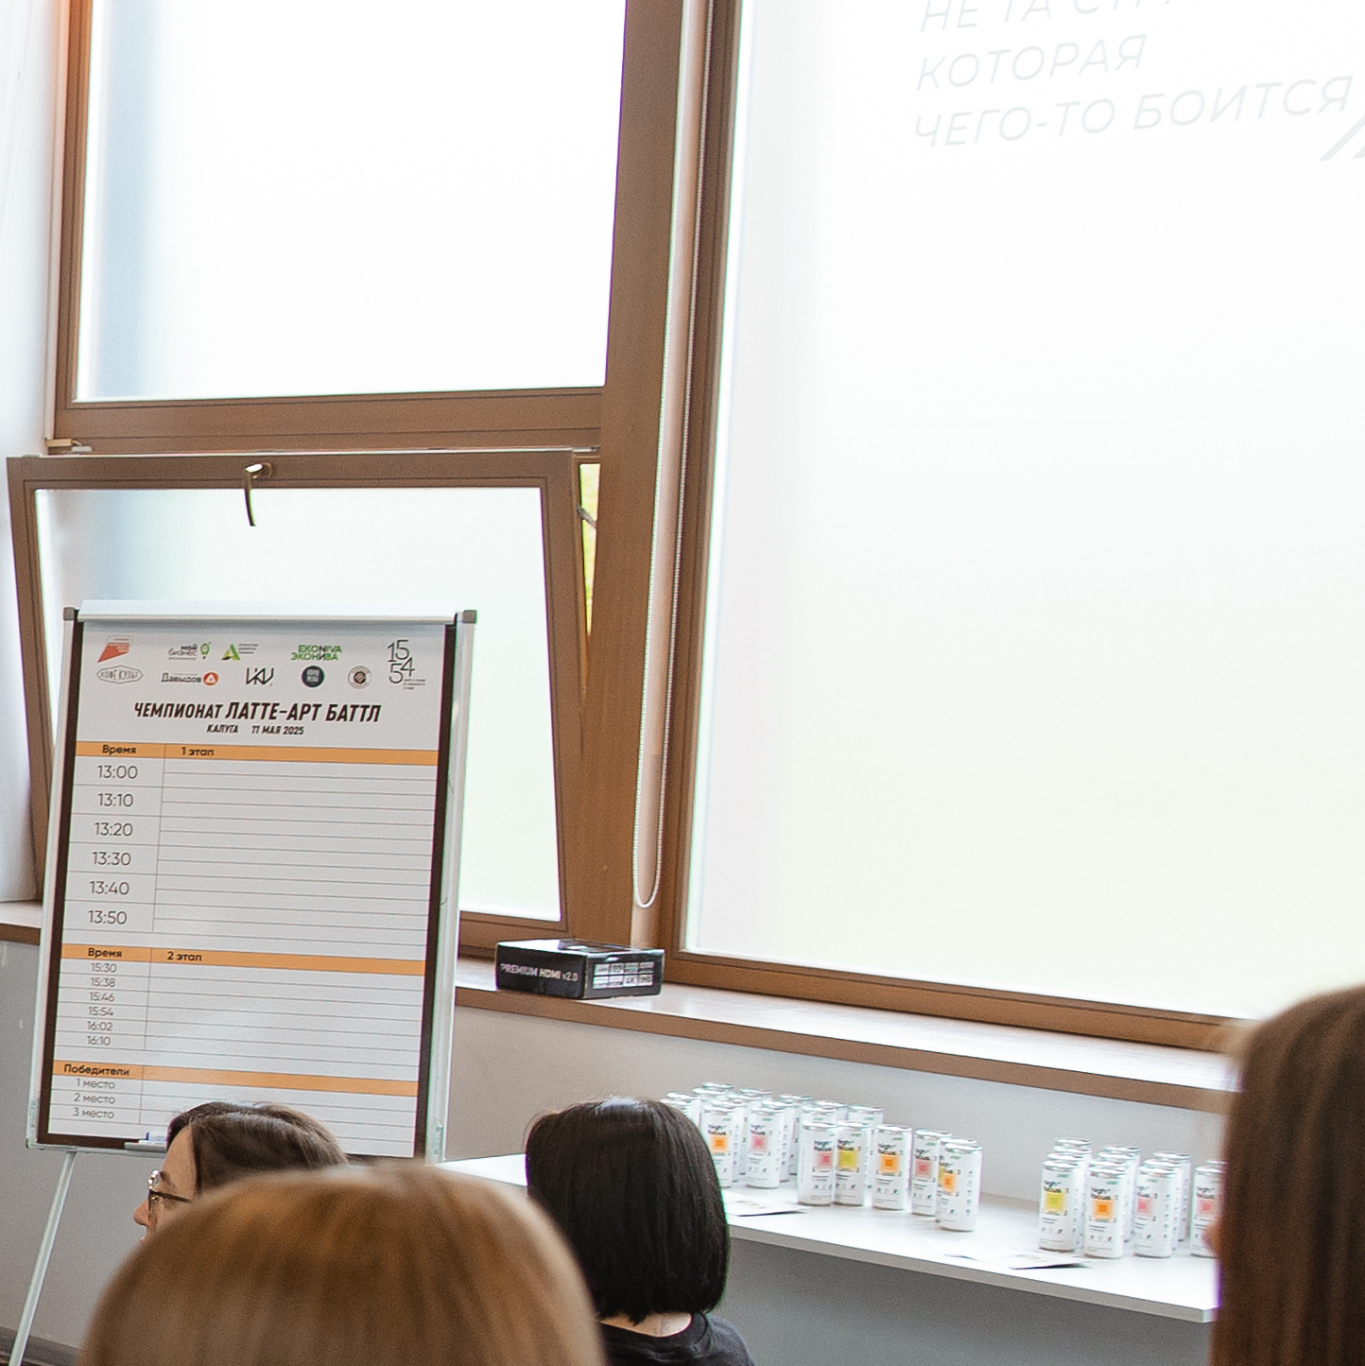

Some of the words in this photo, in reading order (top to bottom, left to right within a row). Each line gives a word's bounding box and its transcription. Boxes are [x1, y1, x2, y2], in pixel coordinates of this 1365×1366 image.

[916, 34, 1147, 91] КОТОРАЯ
[915, 98, 1116, 147] ЧЕГО-ТО
[1133, 75, 1354, 130] БОИТСЯ
[298, 644, 342, 653] EKONIVA
[291, 652, 339, 661] ЭКОНИВА
[134, 702, 223, 719] ЧЕМПИОНАТ
[225, 702, 322, 721] ЛАТТЕ-АРТ
[325, 704, 381, 722] БАТТЛ
[206, 724, 239, 734] КАЛУГА
[251, 725, 260, 735] 11
[261, 725, 281, 735] МАЯ
[283, 726, 305, 735] 2025
[102, 744, 137, 755] Время
[188, 748, 214, 757] этап
[97, 765, 138, 779] 13:00
[98, 793, 134, 807] 13:10
[94, 822, 134, 837] 13:20
[92, 851, 132, 866] 13:30
[89, 881, 130, 895] 13:40
[88, 910, 128, 925] 13:50
[88, 948, 122, 958] Время
[167, 951, 174, 960] 2
[176, 953, 202, 961] этап
[91, 963, 117, 973] 15:30
[539, 968, 561, 980] HDMI
[562, 972, 579, 982] v2.0
[90, 977, 116, 987] 15:38
[89, 992, 115, 1002] 15:46
[88, 1006, 114, 1016] 15:54
[87, 1021, 113, 1031] 16:02
[87, 1036, 111, 1046] 16:10
[64, 1064, 130, 1076] Победители
[83, 1081, 116, 1089] место
[73, 1093, 80, 1102] 2
[83, 1095, 116, 1104] место
[73, 1107, 79, 1117] 3
[82, 1110, 115, 1119] место
